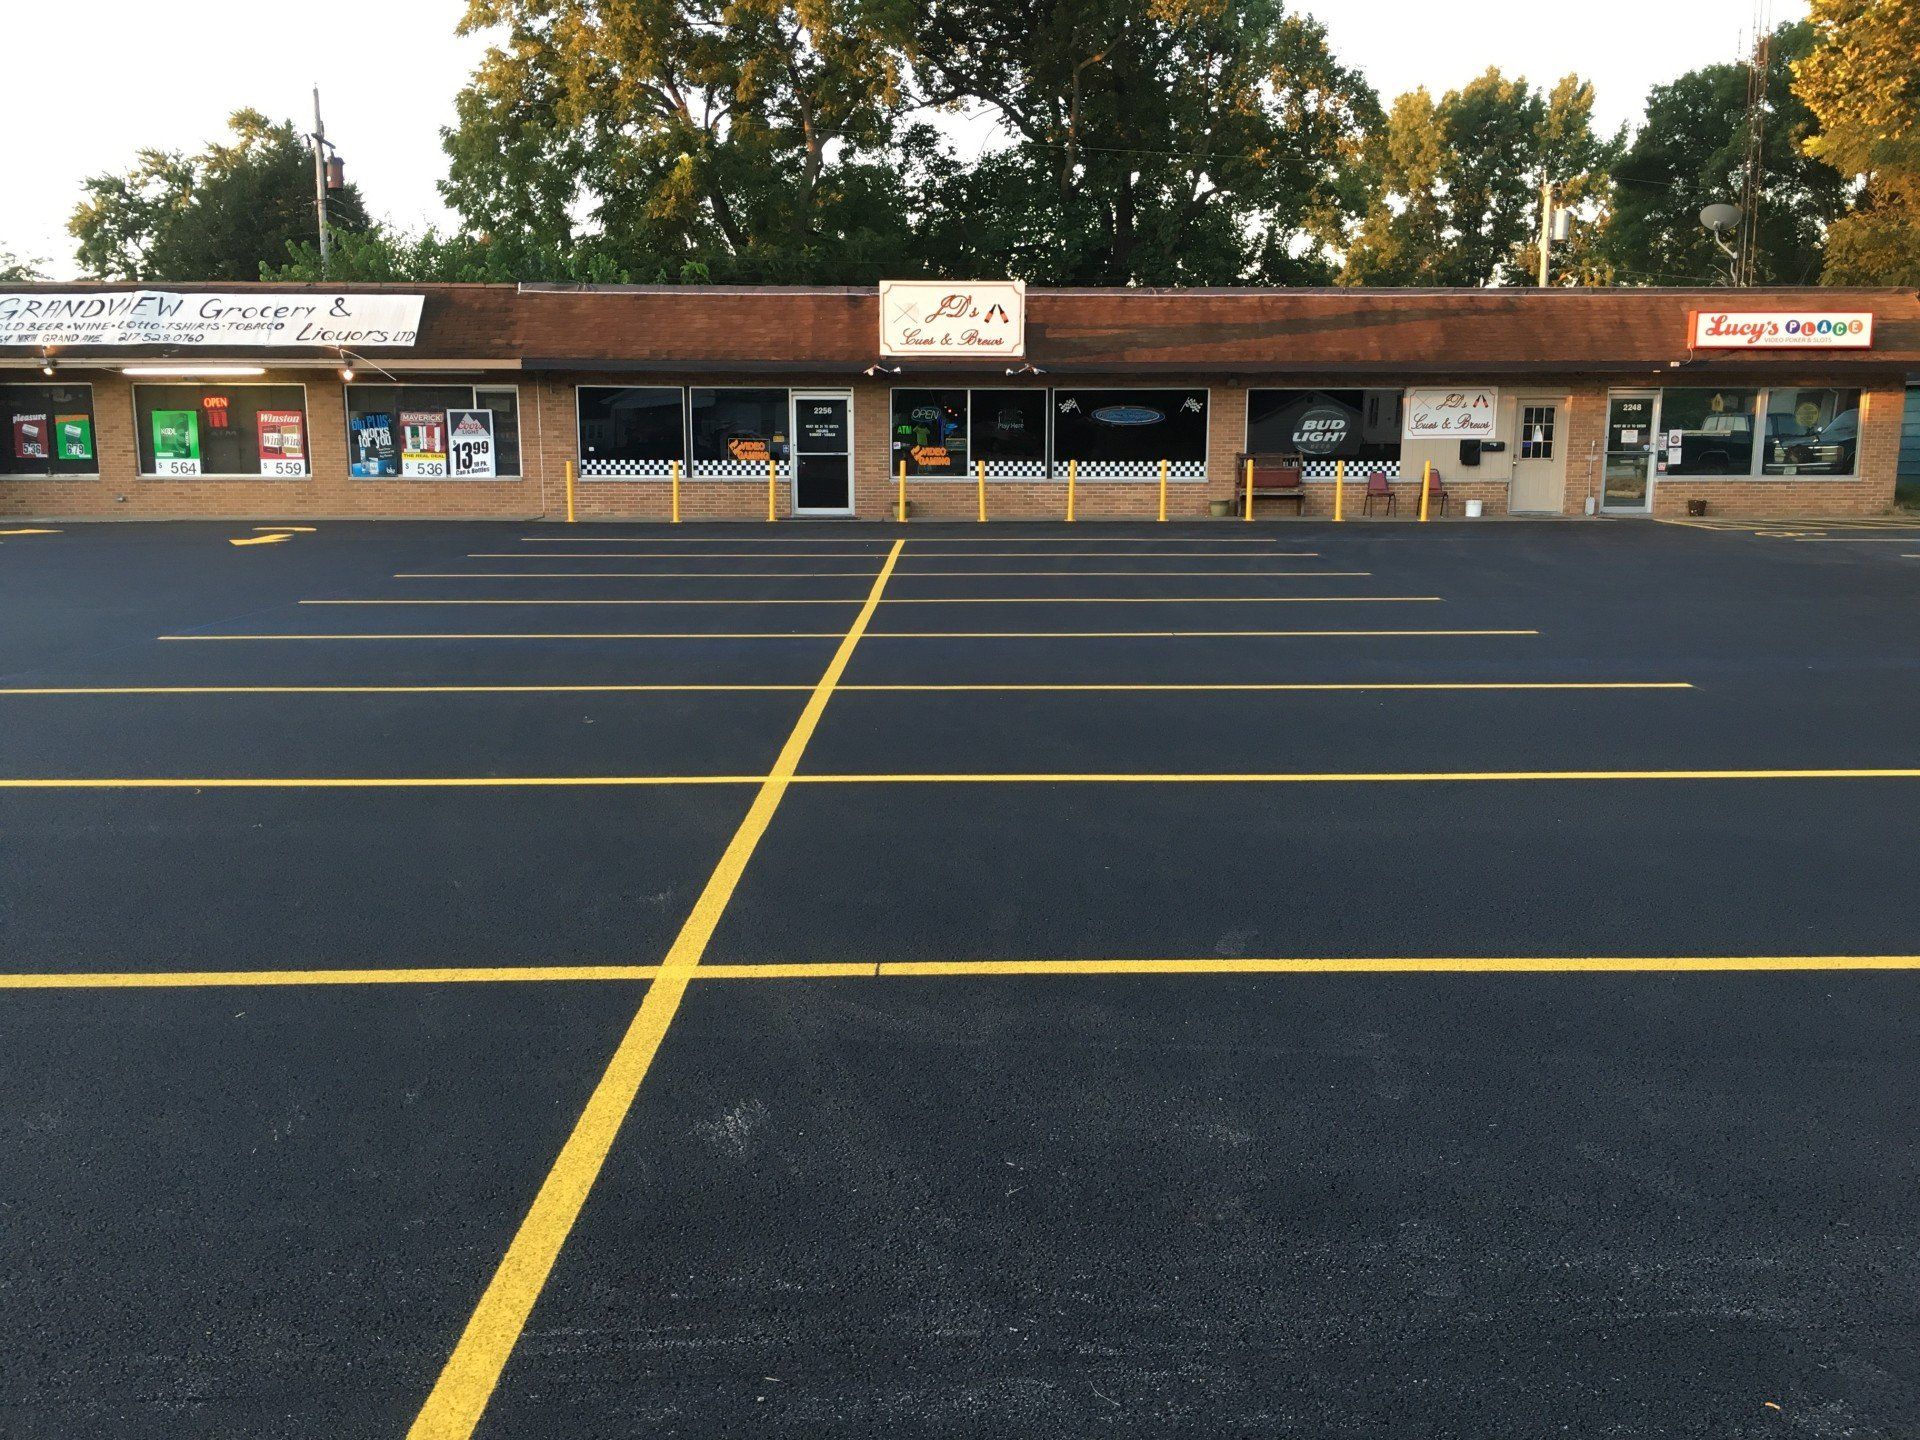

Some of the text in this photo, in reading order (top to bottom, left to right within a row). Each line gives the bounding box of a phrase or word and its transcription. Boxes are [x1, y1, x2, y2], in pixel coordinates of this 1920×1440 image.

[0, 296, 352, 320] GRANDVIEW Grocery &
[925, 294, 979, 323] JD's
[26, 322, 64, 331] BEER
[73, 322, 110, 331] WINE
[227, 322, 285, 331] TOBACCO
[296, 322, 416, 343] Liquors LTD
[1706, 315, 1863, 344] Lucy's PLACE
[42, 333, 79, 343] GRAND
[900, 327, 1004, 346] Cues & Brews
[203, 397, 228, 408] OPEN
[813, 406, 832, 414] 2256
[912, 408, 940, 420] OPEN
[12, 413, 47, 424] pleasure
[260, 413, 299, 423] Winston
[1441, 418, 1451, 430] &
[1453, 413, 1490, 430] Brews
[457, 419, 485, 431] Coors
[897, 425, 912, 435] ATM
[1302, 419, 1346, 431] BUD
[361, 427, 391, 439] works
[1292, 431, 1348, 442] LIGHT
[358, 434, 392, 449] for you
[740, 441, 766, 451] VIDEO
[921, 447, 946, 456] VIDEO
